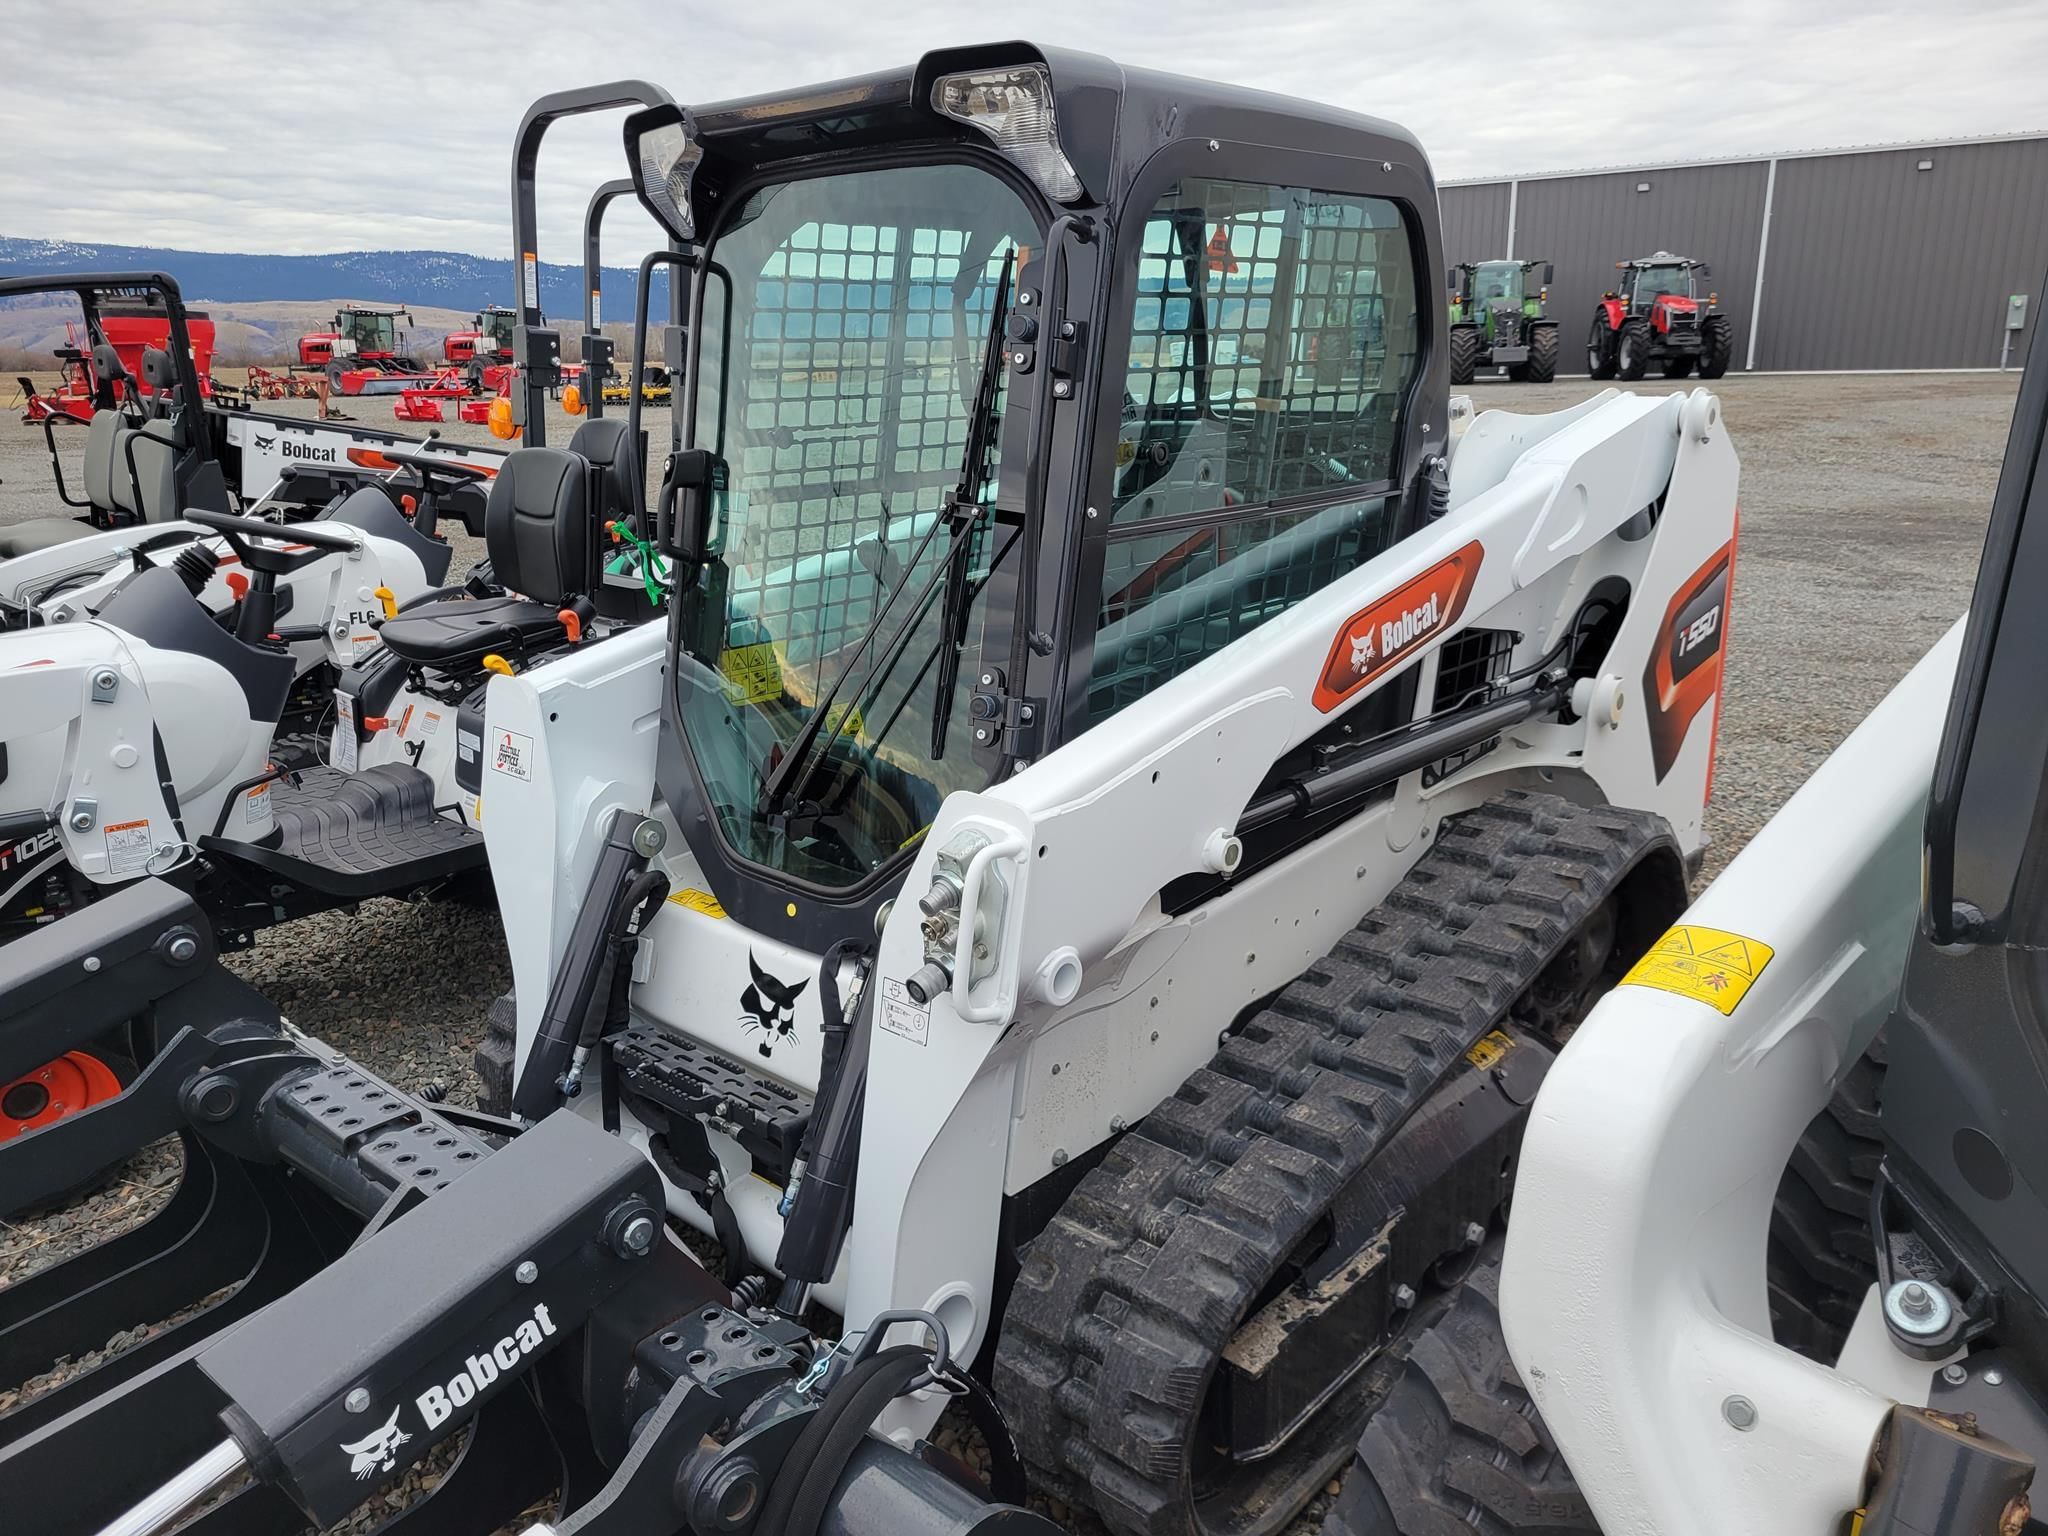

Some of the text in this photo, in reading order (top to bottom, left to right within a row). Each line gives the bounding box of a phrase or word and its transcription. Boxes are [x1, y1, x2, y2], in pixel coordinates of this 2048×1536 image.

[282, 440, 336, 462] Bobcat
[1381, 592, 1438, 658] Bobcat
[415, 1302, 558, 1431] Bobcat
